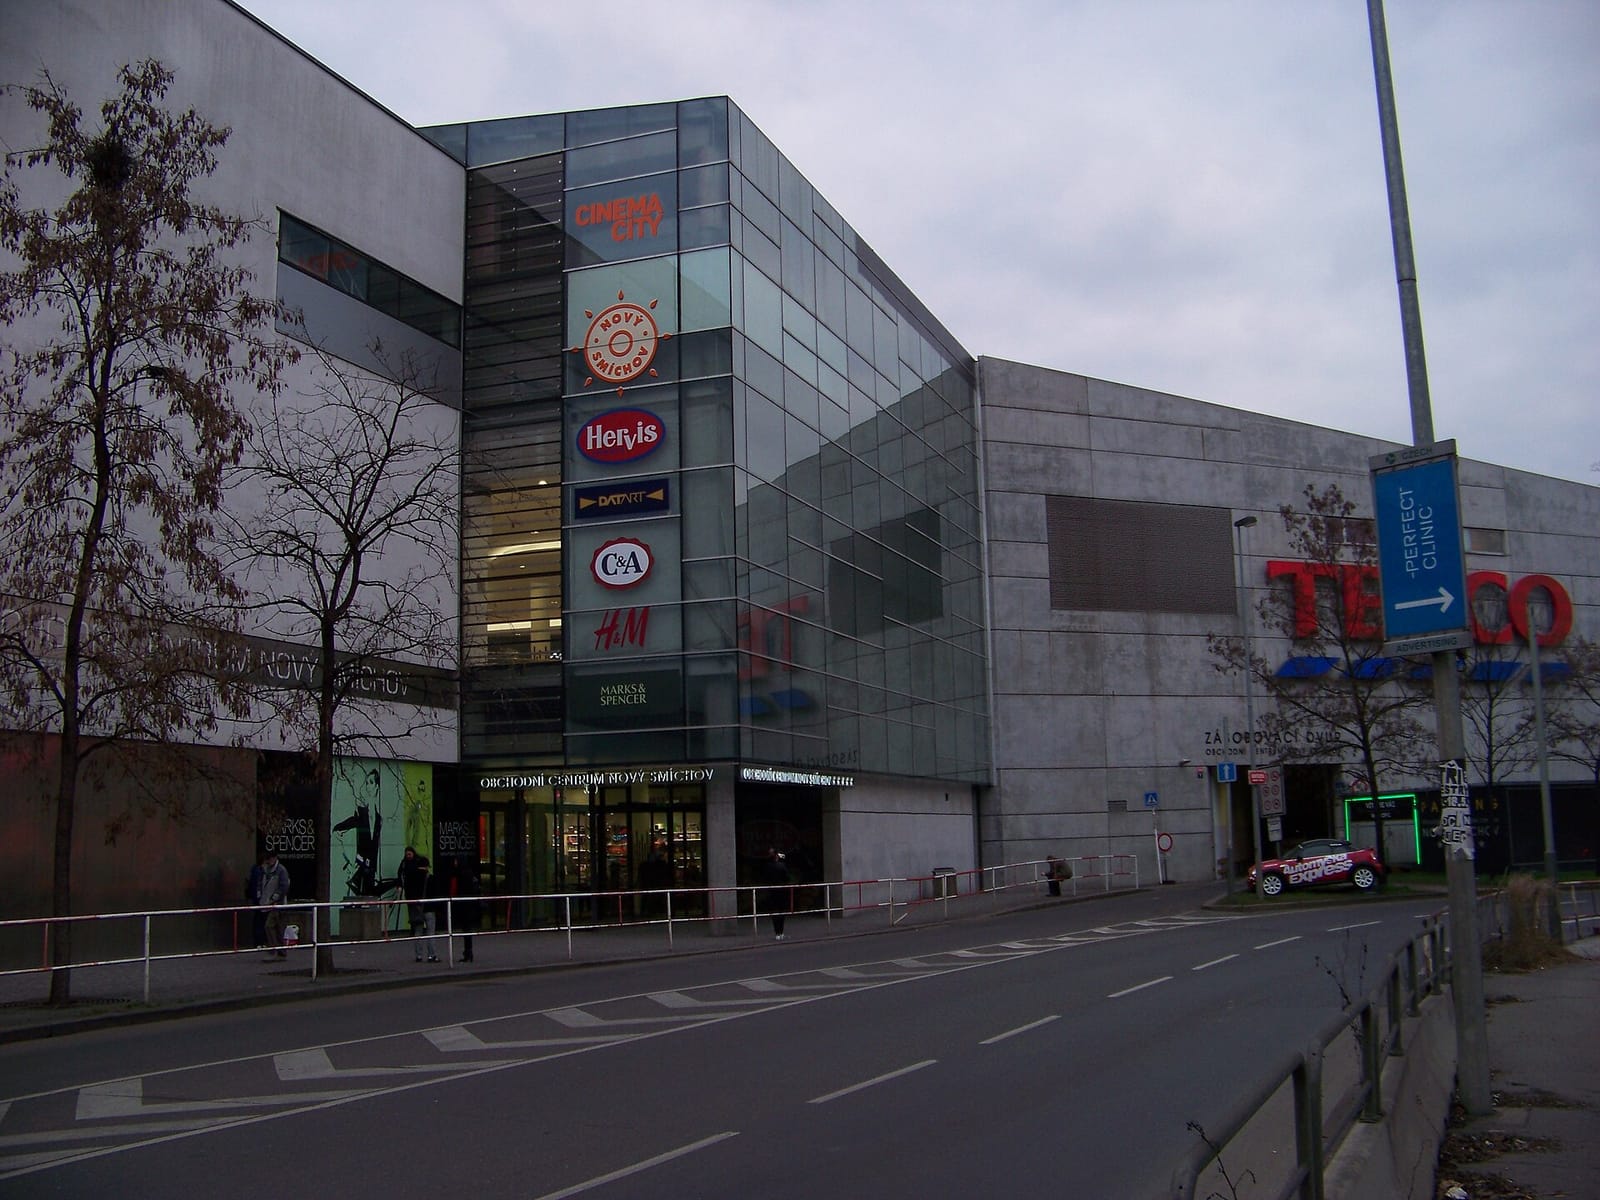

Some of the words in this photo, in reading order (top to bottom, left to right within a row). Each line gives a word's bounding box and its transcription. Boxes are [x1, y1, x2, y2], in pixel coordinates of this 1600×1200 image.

[575, 192, 664, 226] CINEMA
[611, 215, 662, 242] CITY
[600, 312, 644, 332] NOVÝ
[592, 345, 649, 377] SMÍCHOV
[586, 420, 658, 451] Hervis
[598, 490, 645, 507] DATART
[1418, 505, 1437, 570] CLINIC
[601, 550, 644, 576] C&A
[1267, 561, 1573, 647] TECO
[594, 606, 651, 651] H&M
[1396, 637, 1458, 653] ADVERTISING
[261, 648, 320, 683] NOVÝ
[600, 693, 648, 706] SPENCER
[480, 772, 544, 789] OBCHODNÍ
[548, 771, 605, 787] CENTRUM
[608, 769, 646, 784] NOVÝ
[649, 767, 714, 783] SMÍCHOV
[265, 835, 316, 852] SPENCER
